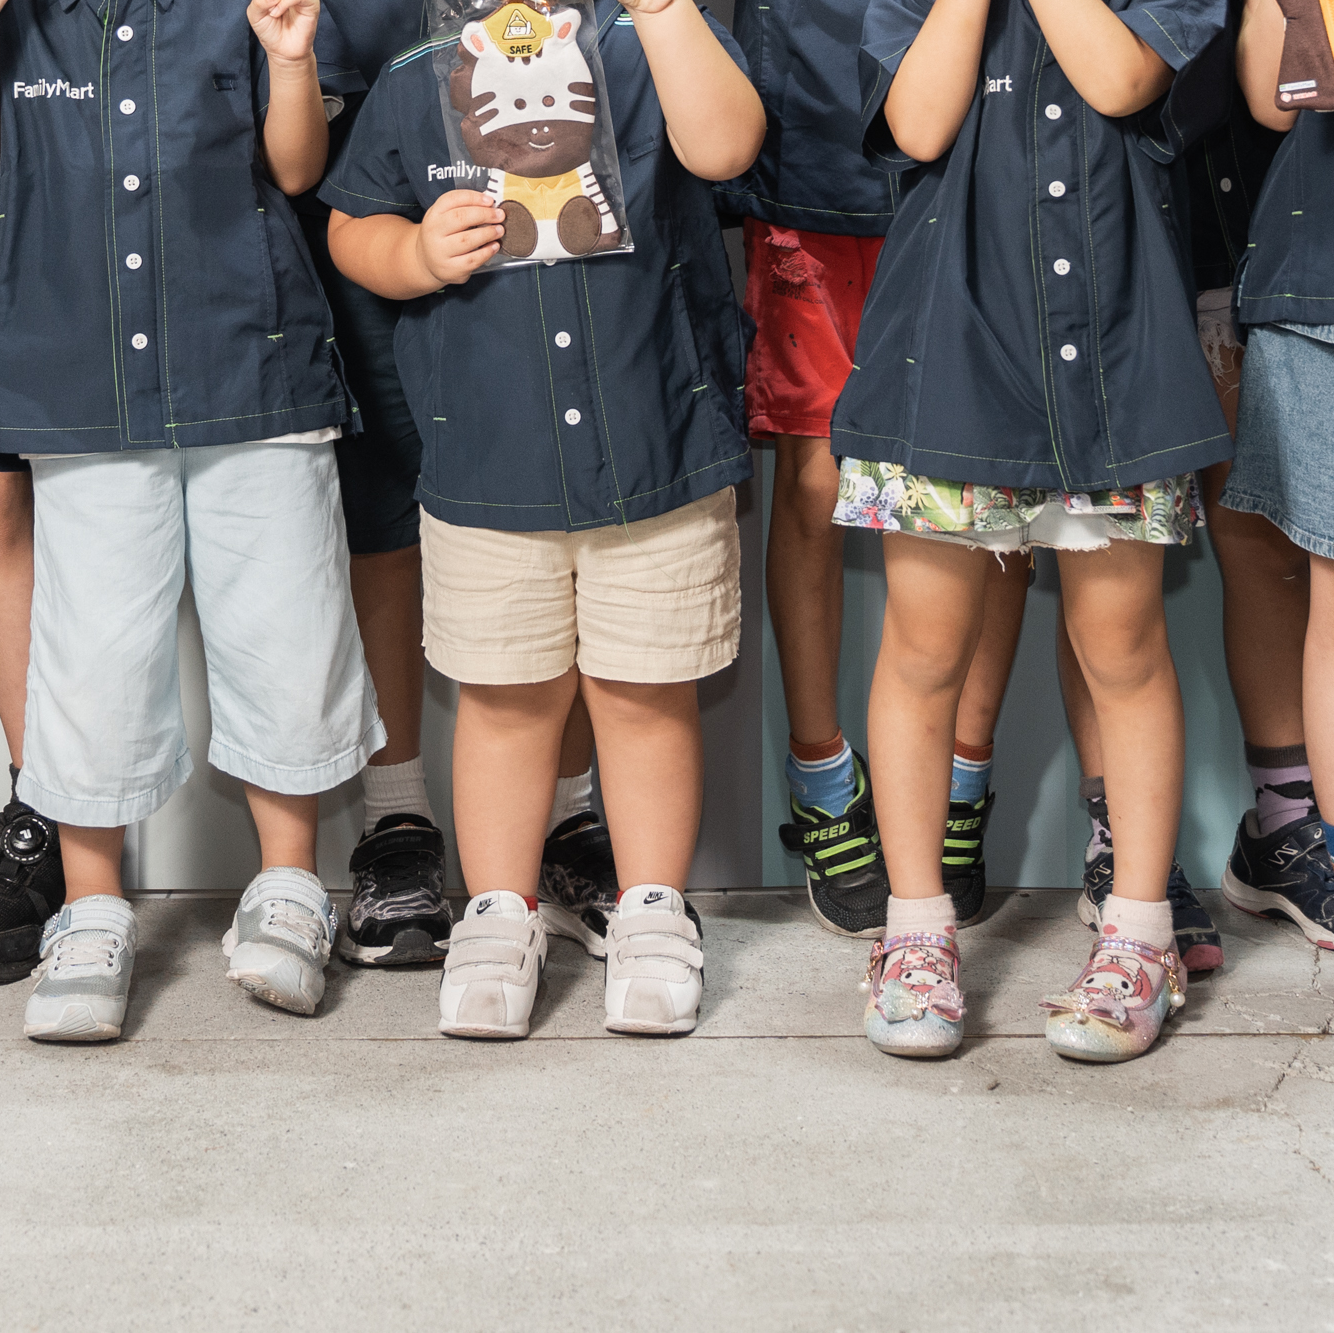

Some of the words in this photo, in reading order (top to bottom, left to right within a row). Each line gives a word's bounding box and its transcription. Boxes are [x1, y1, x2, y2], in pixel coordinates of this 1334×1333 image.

[509, 44, 533, 55] SAFE
[946, 816, 982, 832] PEED
[803, 821, 851, 844] SPEED
[646, 891, 666, 901] NIKE
[478, 897, 493, 909] NIKE
